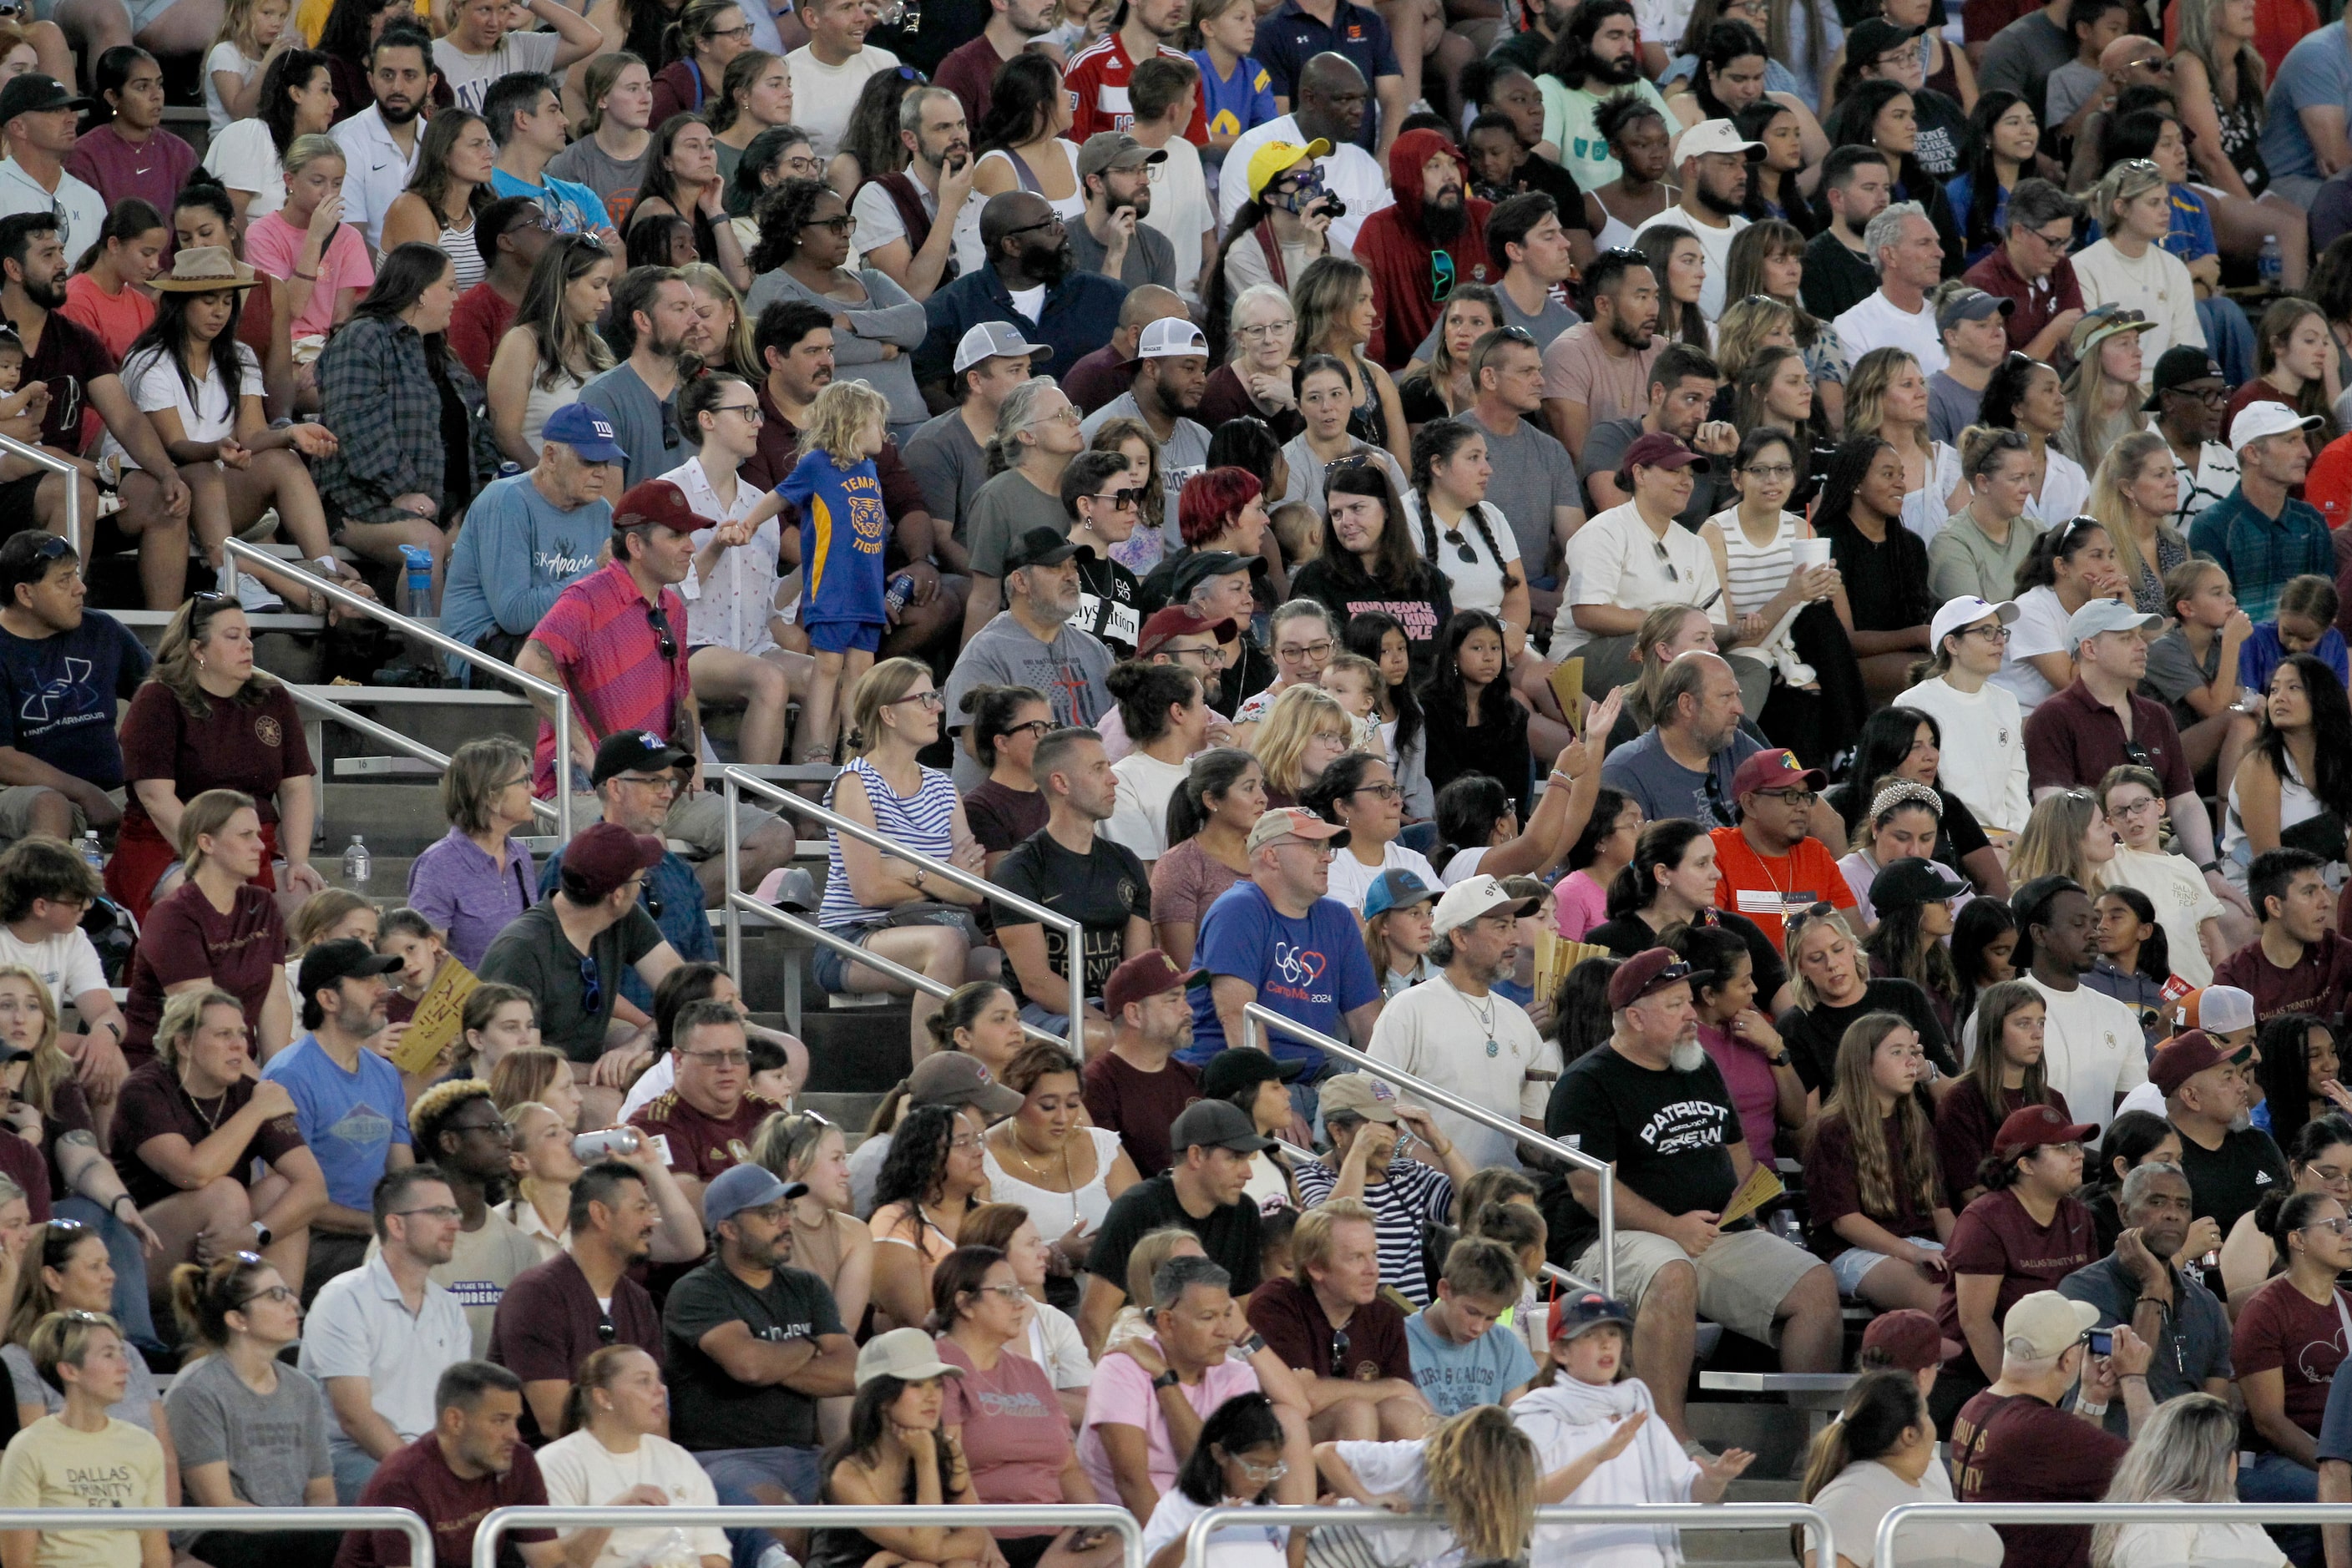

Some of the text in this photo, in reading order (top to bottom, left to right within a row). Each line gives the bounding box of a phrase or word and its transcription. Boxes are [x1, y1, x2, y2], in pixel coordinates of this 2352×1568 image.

[1347, 600, 1434, 614] KIND PEOPLE
[1404, 613, 1438, 626] KIND
[1403, 625, 1433, 640] PLE
[61, 711, 105, 726] ARMOUR
[358, 760, 367, 770] 16
[525, 839, 534, 849] 15
[2172, 882, 2199, 900] DALS
[1045, 930, 1121, 955] DLLA
[1049, 956, 1120, 981] TRNIT
[1311, 994, 1332, 1004] 2024
[2259, 1007, 2285, 1021] DALLAS
[2286, 999, 2314, 1011] TRINITY
[1639, 1100, 1728, 1145] PATRIOT
[1657, 1125, 1722, 1152] CREW
[67, 1467, 130, 1483] DALLAS
[1951, 1457, 1984, 1493] TRIITY
[68, 1483, 133, 1496] TRINITY
[88, 1498, 109, 1508] FC
